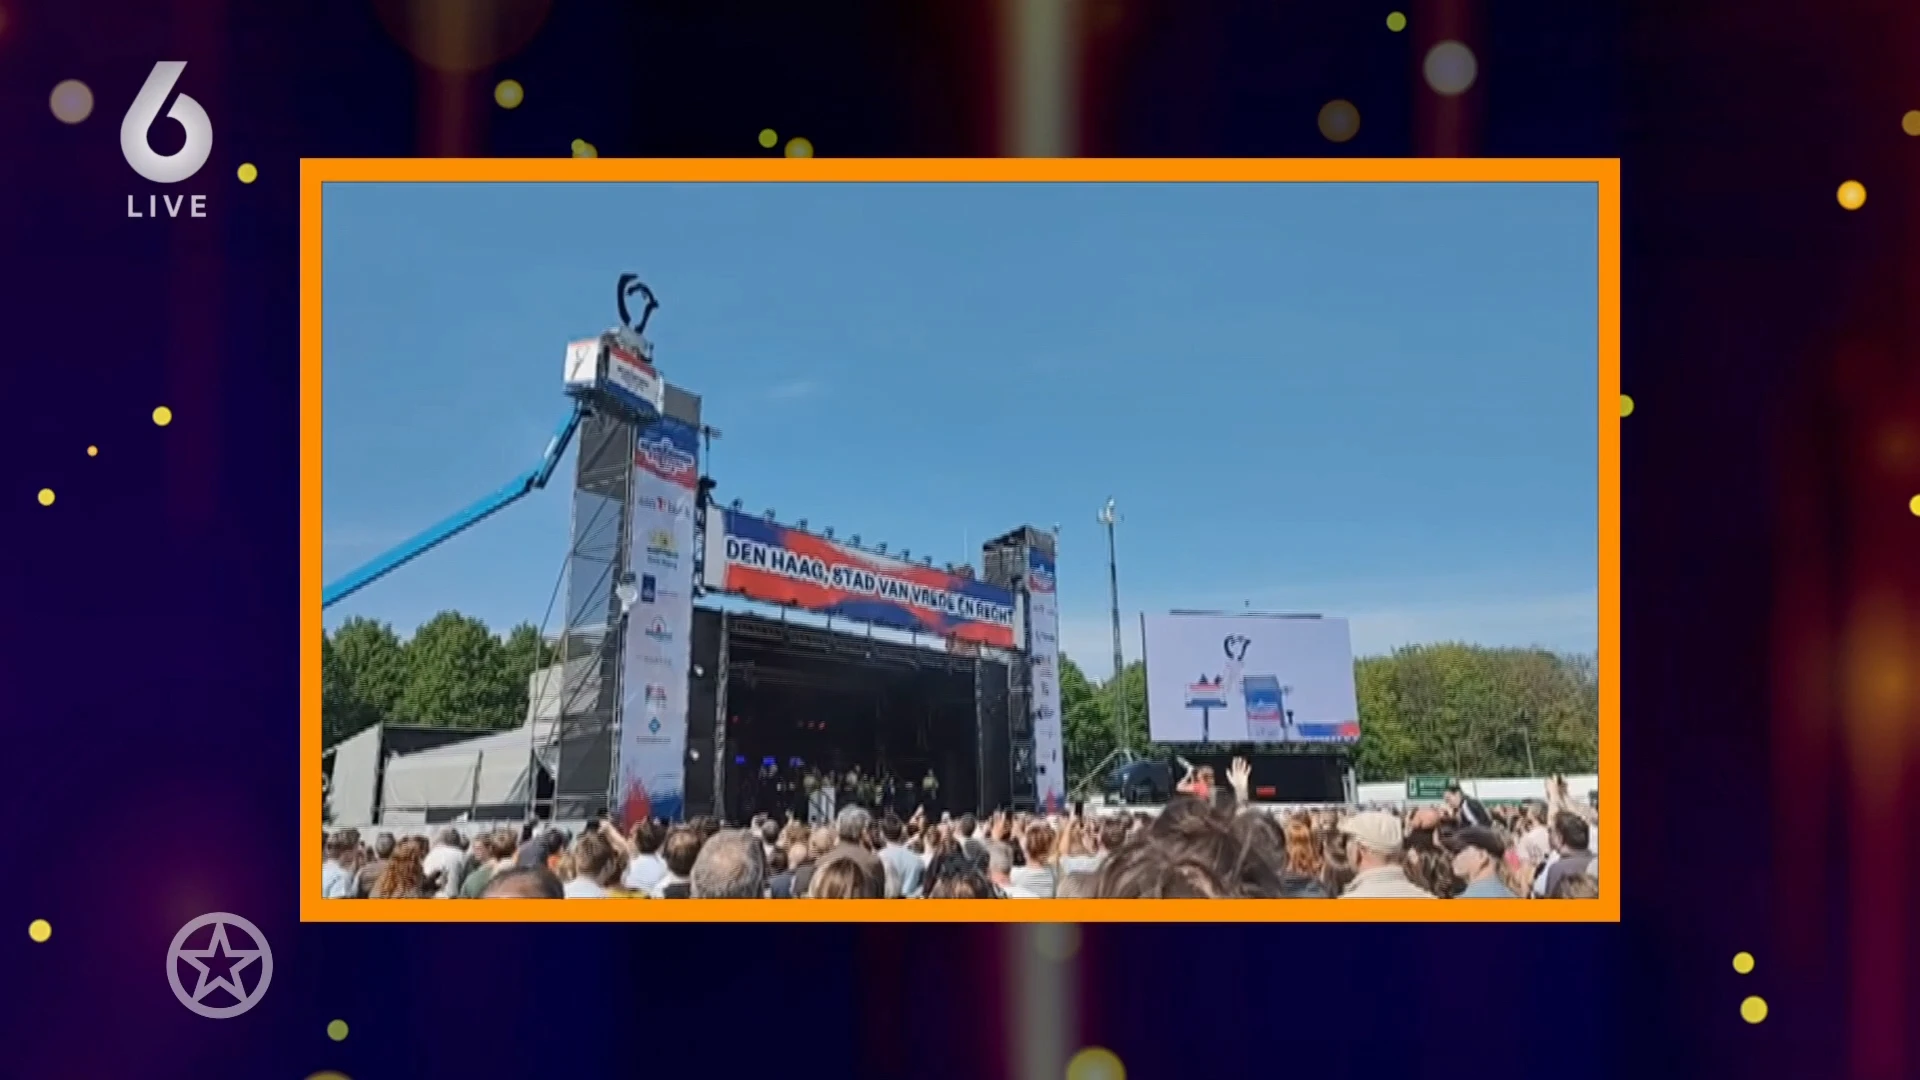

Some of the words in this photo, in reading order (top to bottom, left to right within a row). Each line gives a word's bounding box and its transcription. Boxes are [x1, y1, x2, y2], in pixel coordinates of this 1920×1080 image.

[726, 539, 766, 566] DEN
[772, 551, 829, 586] HAAG,
[833, 568, 876, 590] STAD
[879, 578, 909, 600] VAN
[912, 586, 955, 611] VREDE
[958, 597, 974, 615] EN
[976, 602, 1014, 624] RECHT
